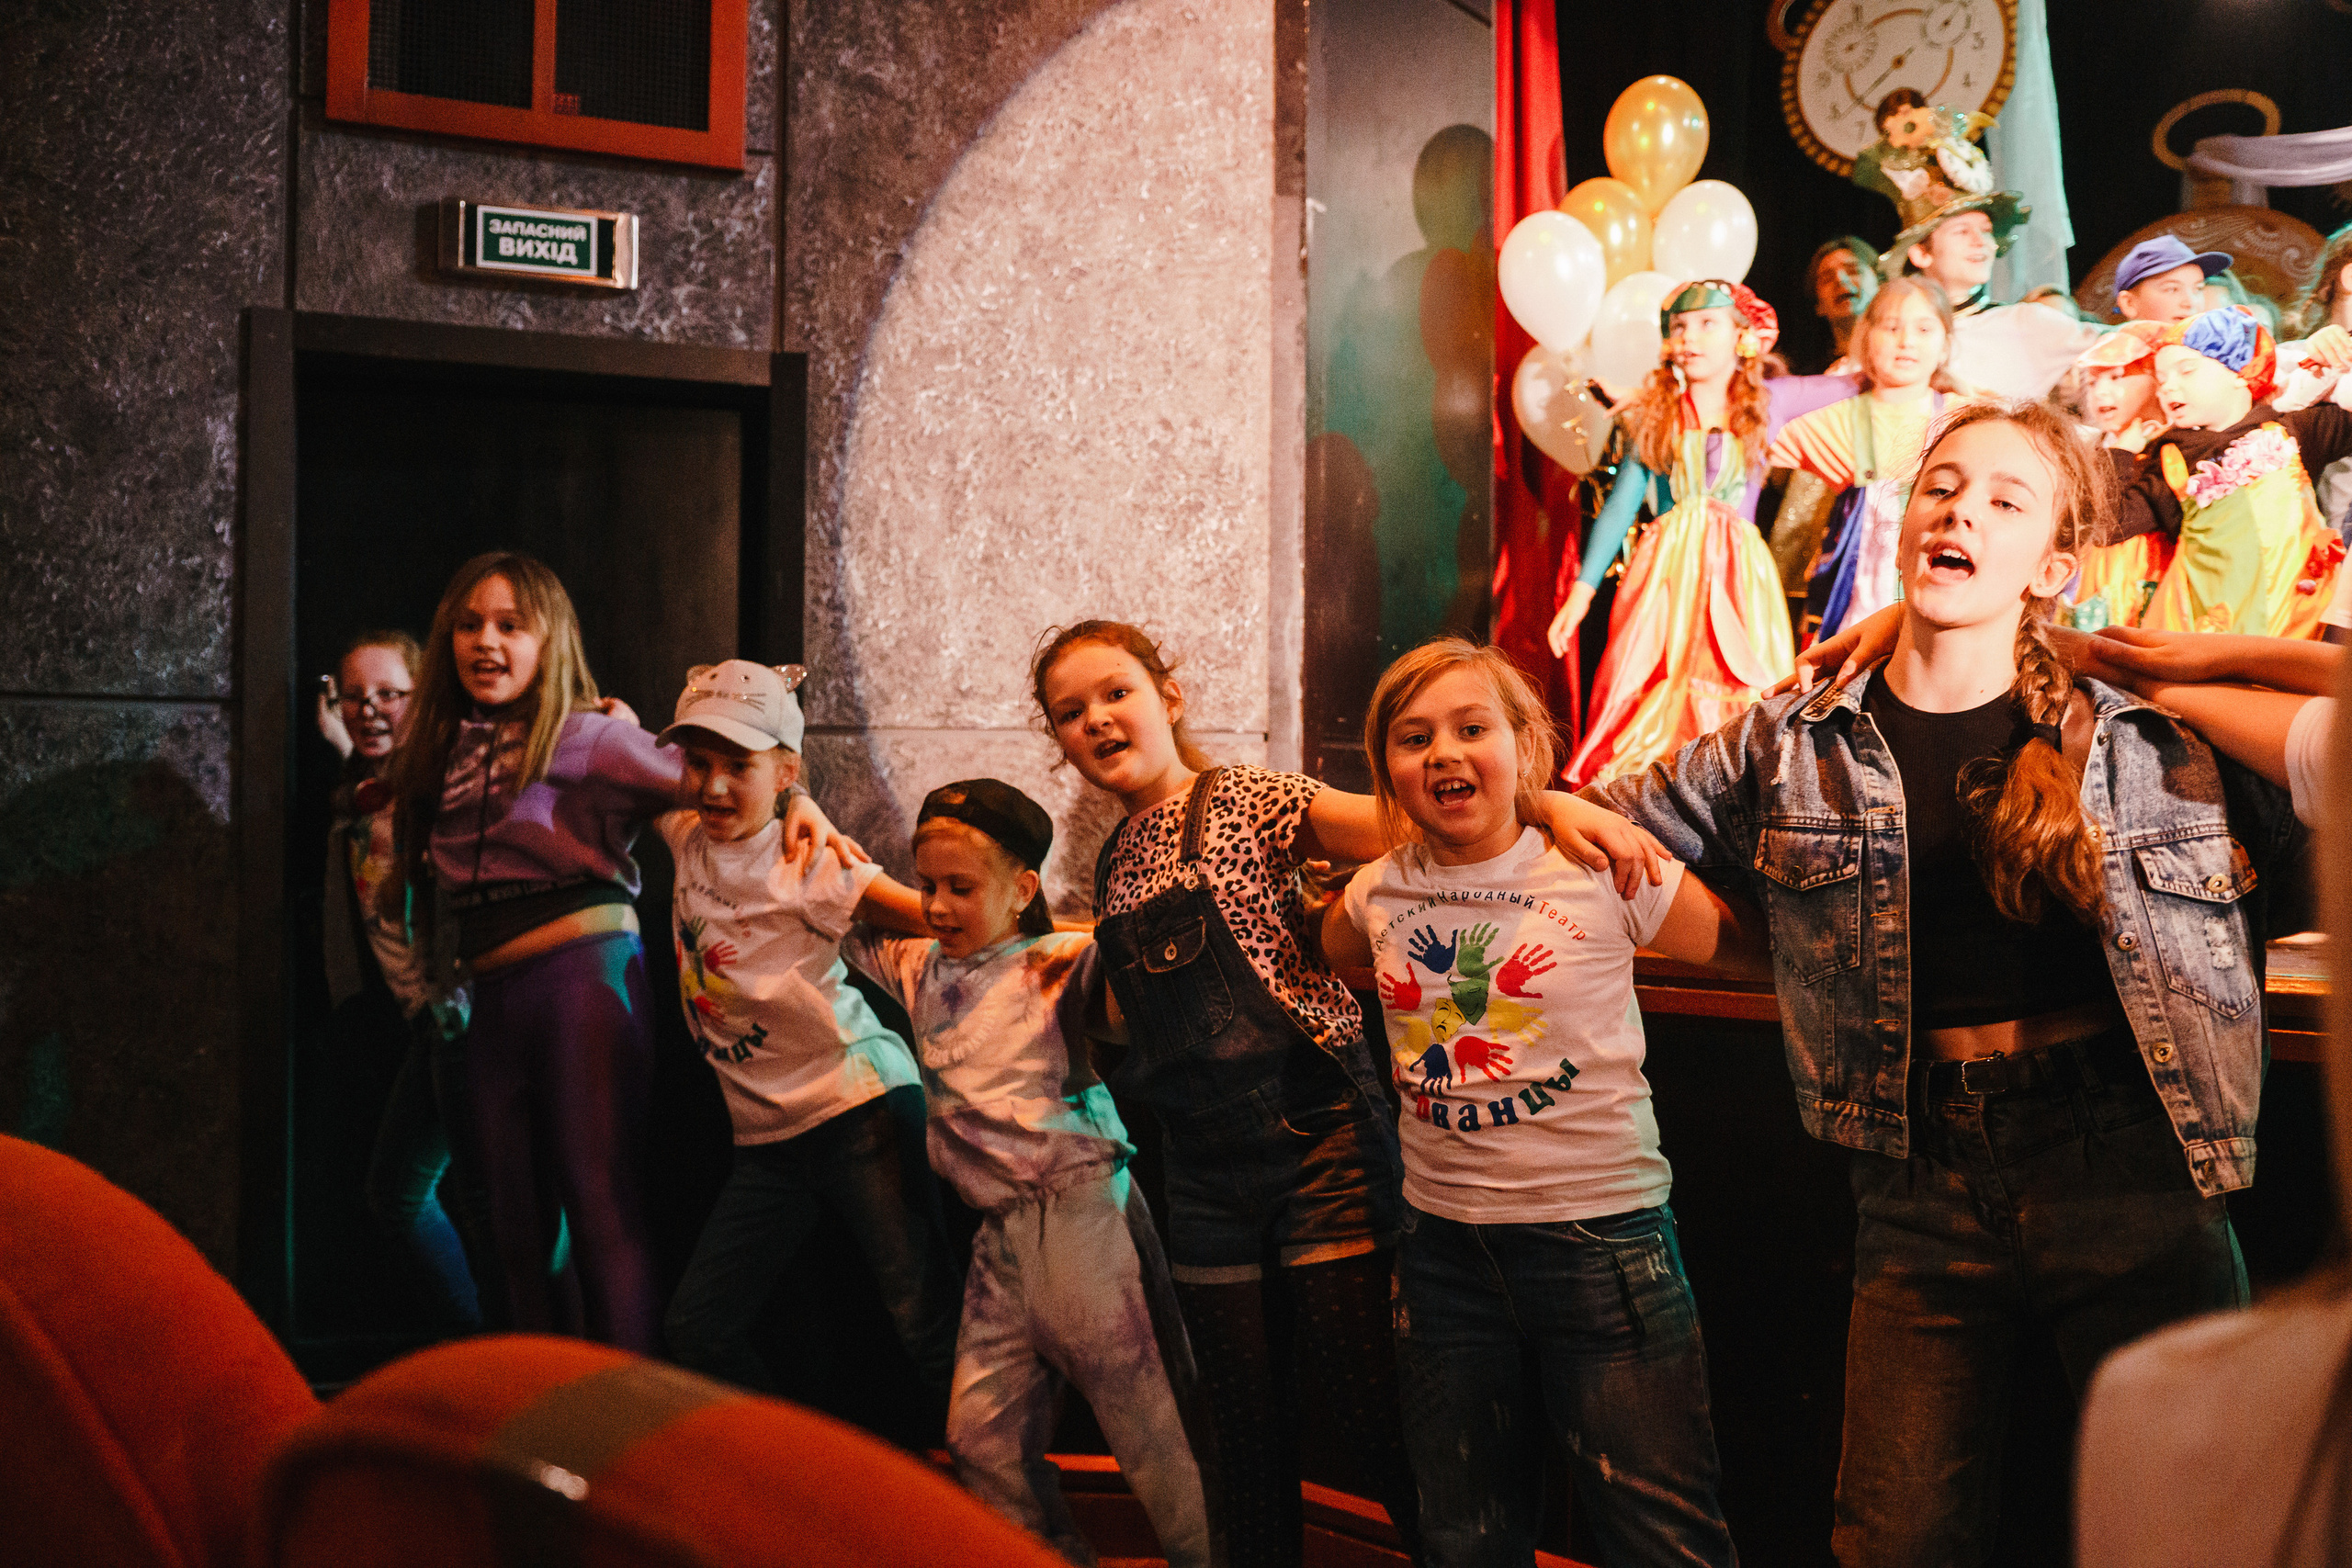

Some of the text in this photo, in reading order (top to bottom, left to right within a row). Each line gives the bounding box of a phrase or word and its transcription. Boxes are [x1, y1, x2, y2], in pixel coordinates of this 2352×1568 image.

[489, 219, 587, 242] ЗАПАСНИЙ
[499, 236, 578, 265] ВИХІД
[1538, 900, 1586, 941] Театр
